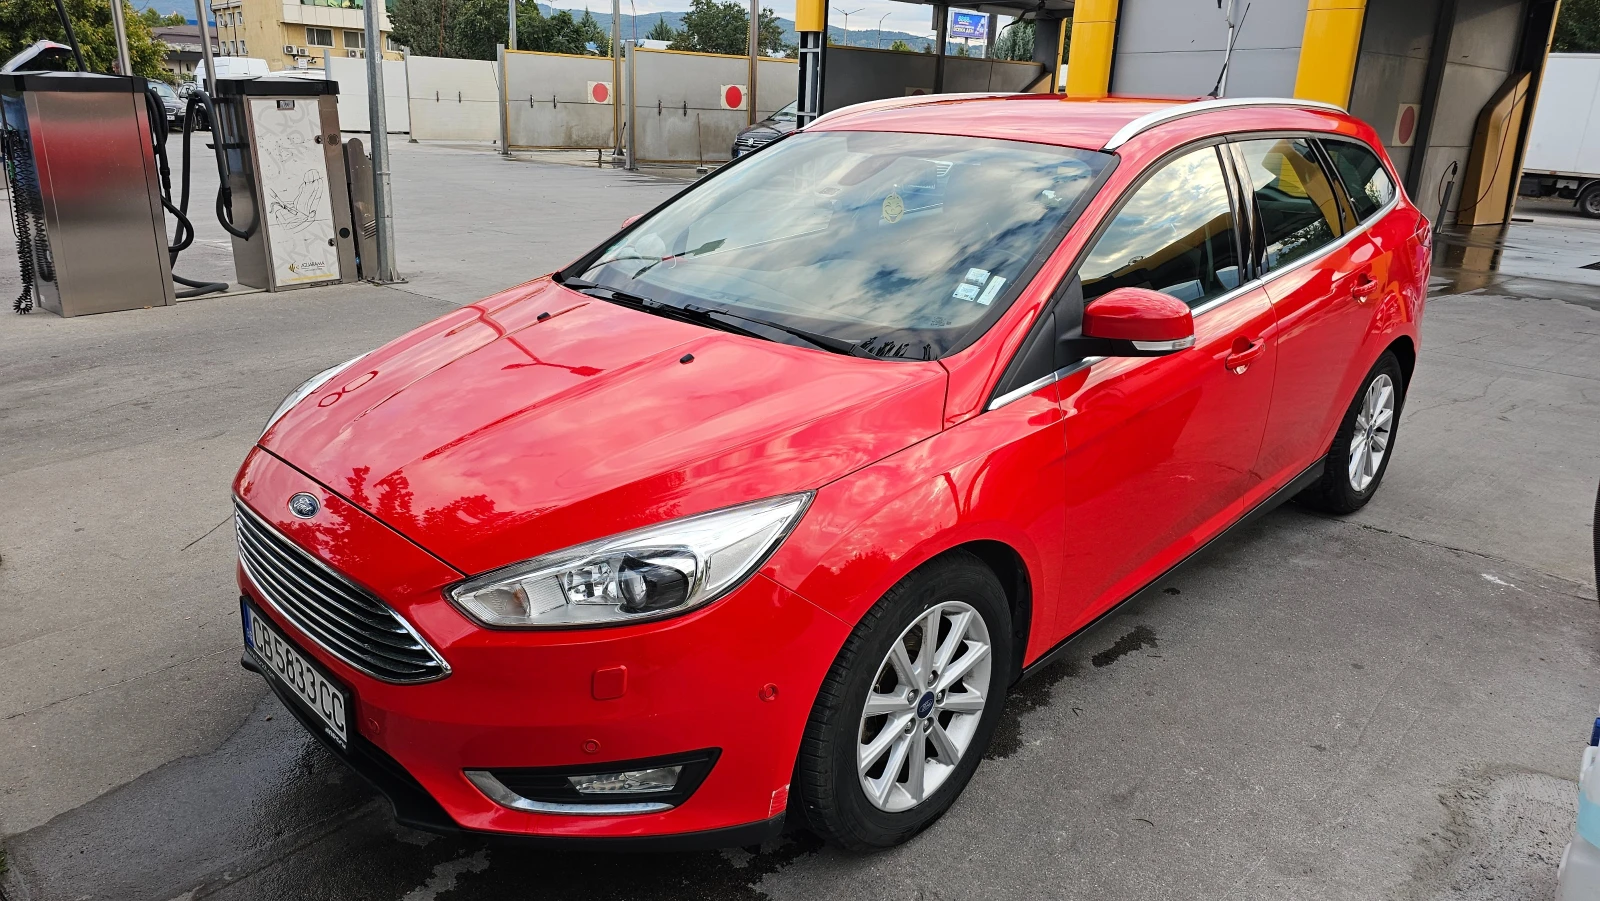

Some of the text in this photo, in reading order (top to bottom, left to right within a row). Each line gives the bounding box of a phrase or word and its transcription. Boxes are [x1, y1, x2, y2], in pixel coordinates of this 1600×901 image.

[253, 616, 273, 662] CB
[274, 635, 317, 704] 5833
[320, 680, 345, 733] CC
